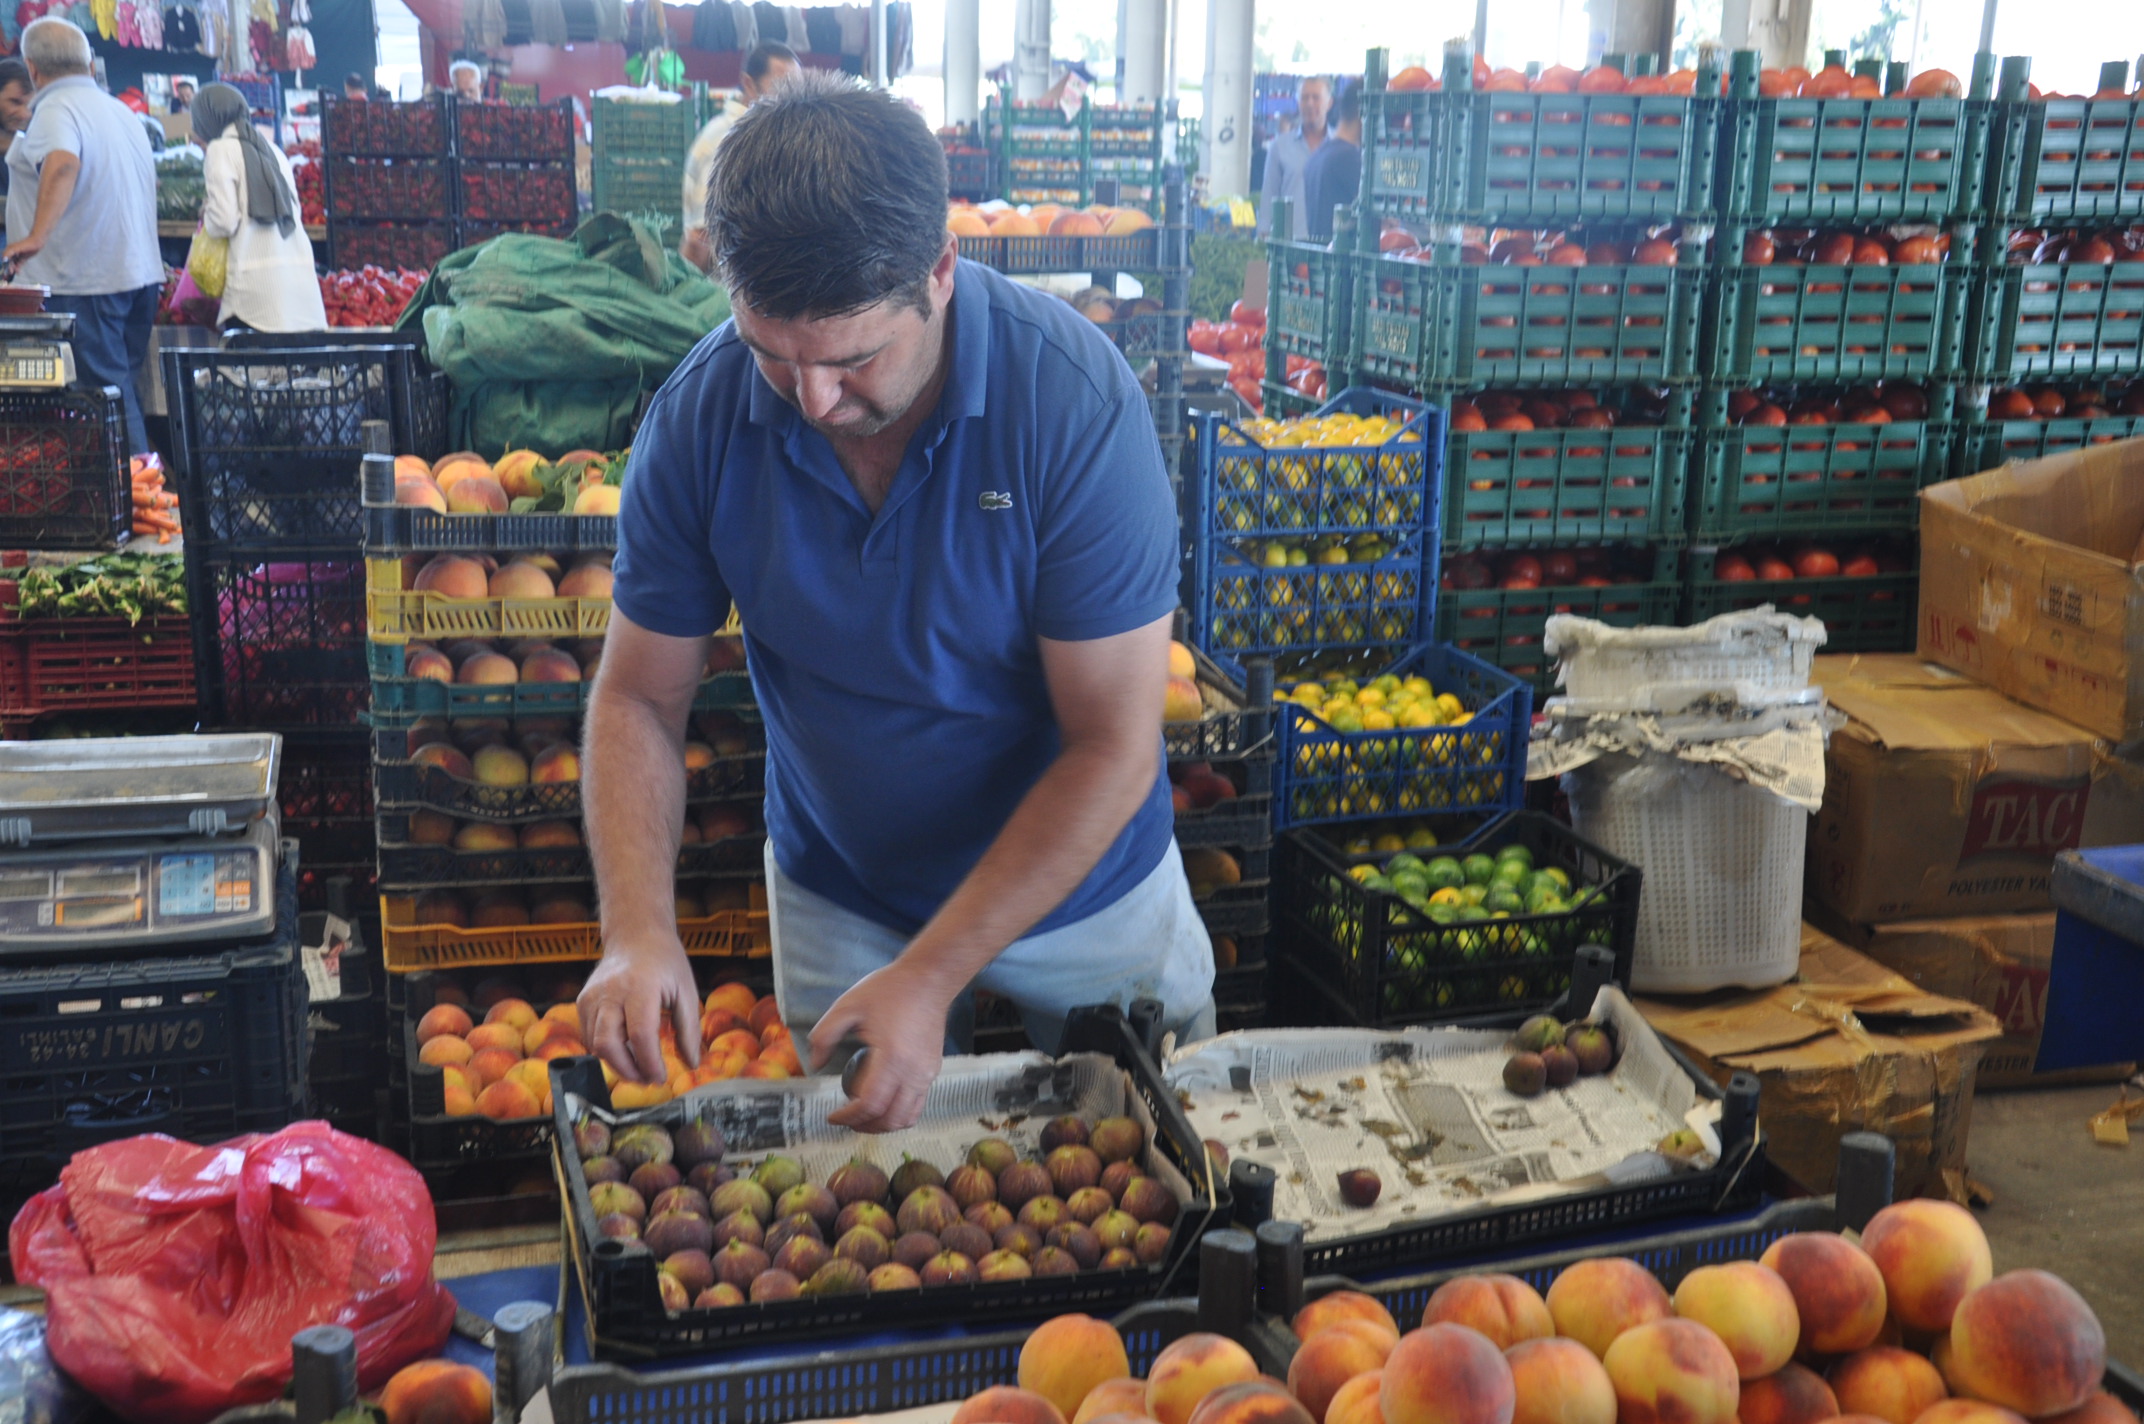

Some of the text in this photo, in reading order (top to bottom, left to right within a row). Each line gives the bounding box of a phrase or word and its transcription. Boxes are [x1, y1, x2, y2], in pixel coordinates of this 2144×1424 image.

[1982, 792, 2078, 849] TAC
[1948, 874, 2025, 897] POLYESTER
[101, 1019, 205, 1058] CANLI
